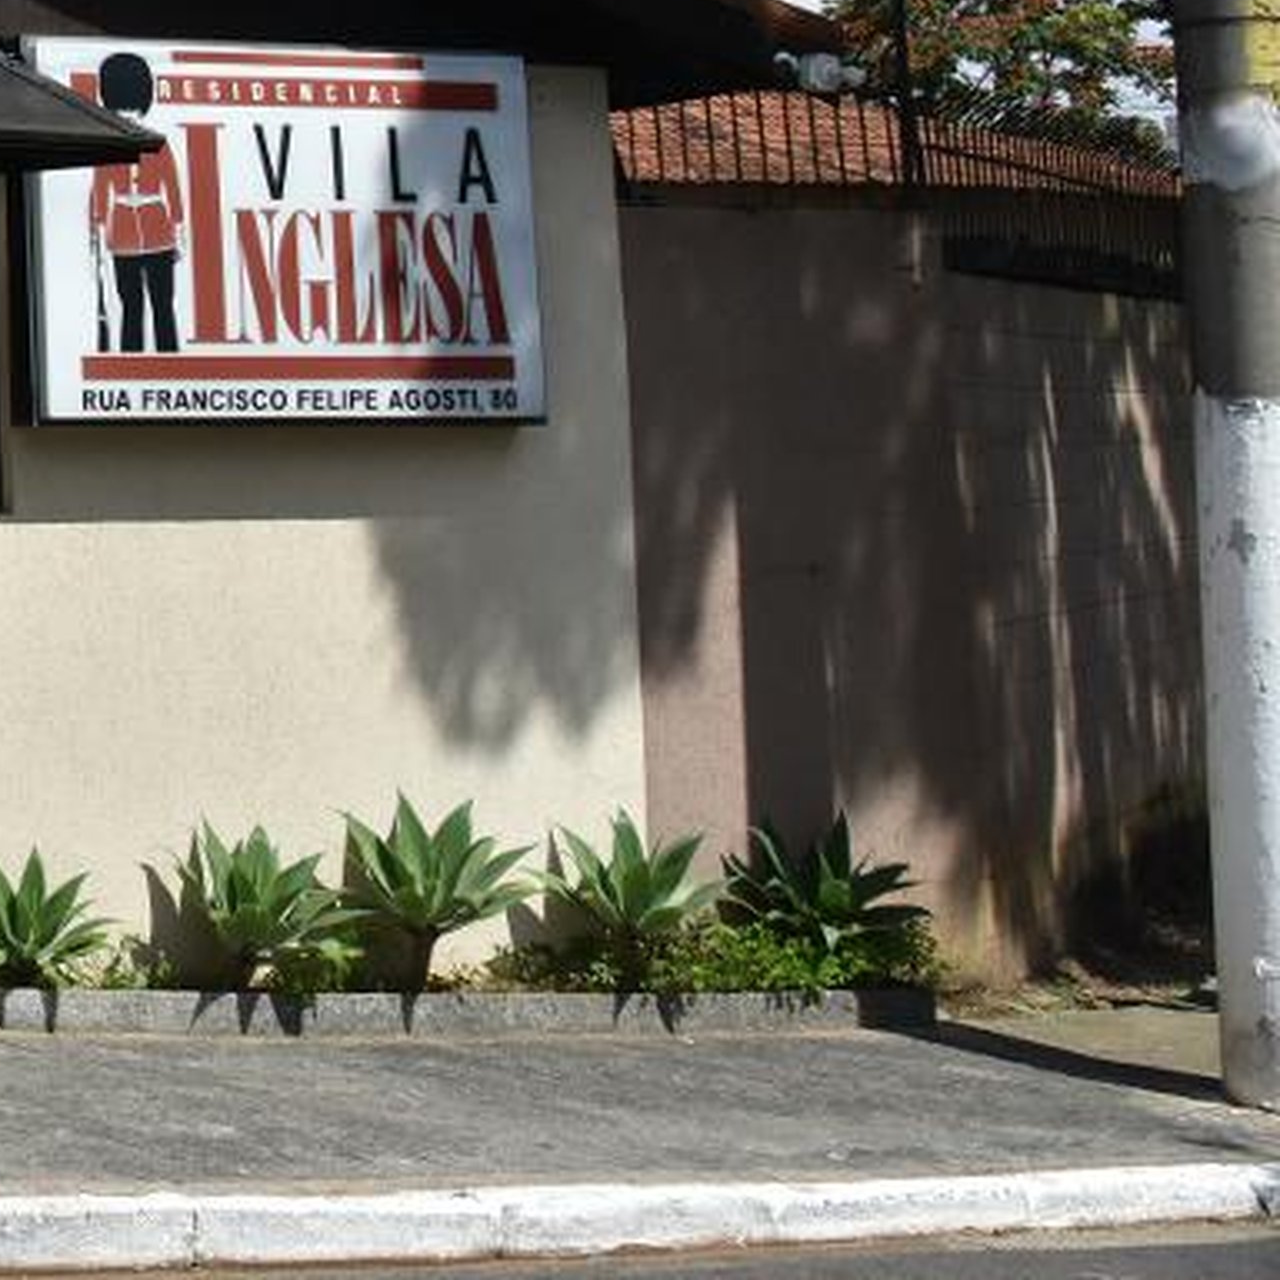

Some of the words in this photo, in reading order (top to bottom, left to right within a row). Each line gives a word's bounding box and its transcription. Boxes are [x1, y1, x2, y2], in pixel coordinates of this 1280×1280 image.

[157, 78, 403, 105] RESIDENCIAL
[252, 124, 497, 204] VILA
[183, 122, 511, 345] INGLESA
[82, 389, 131, 411] RUA
[142, 389, 288, 411] FRANCISCO
[296, 389, 379, 411] FELIPE
